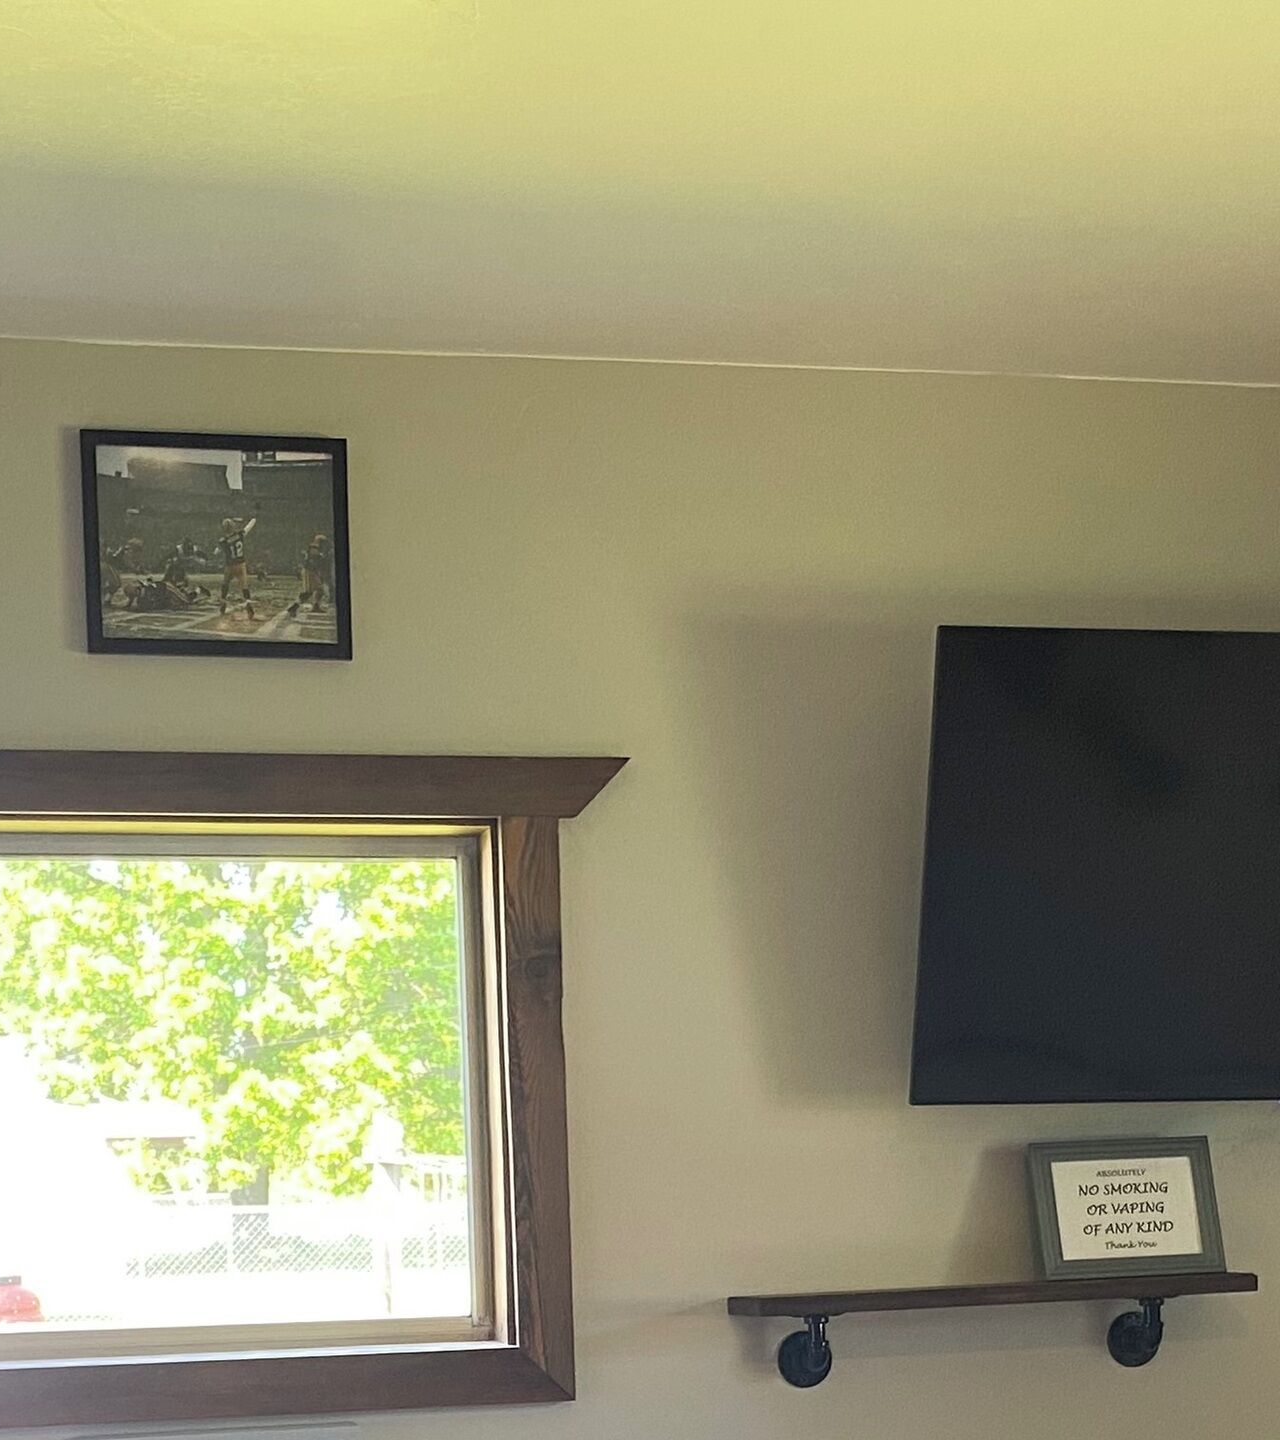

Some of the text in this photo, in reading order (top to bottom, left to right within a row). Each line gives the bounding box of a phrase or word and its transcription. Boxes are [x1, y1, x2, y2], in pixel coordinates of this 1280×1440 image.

[1096, 1168, 1147, 1177] ABSOLUTELY
[1078, 1181, 1168, 1197] NO SMOKING
[1086, 1201, 1165, 1216] OR VAPING
[1083, 1220, 1174, 1237] OF ANY KIND
[1105, 1240, 1158, 1250] Thank You
